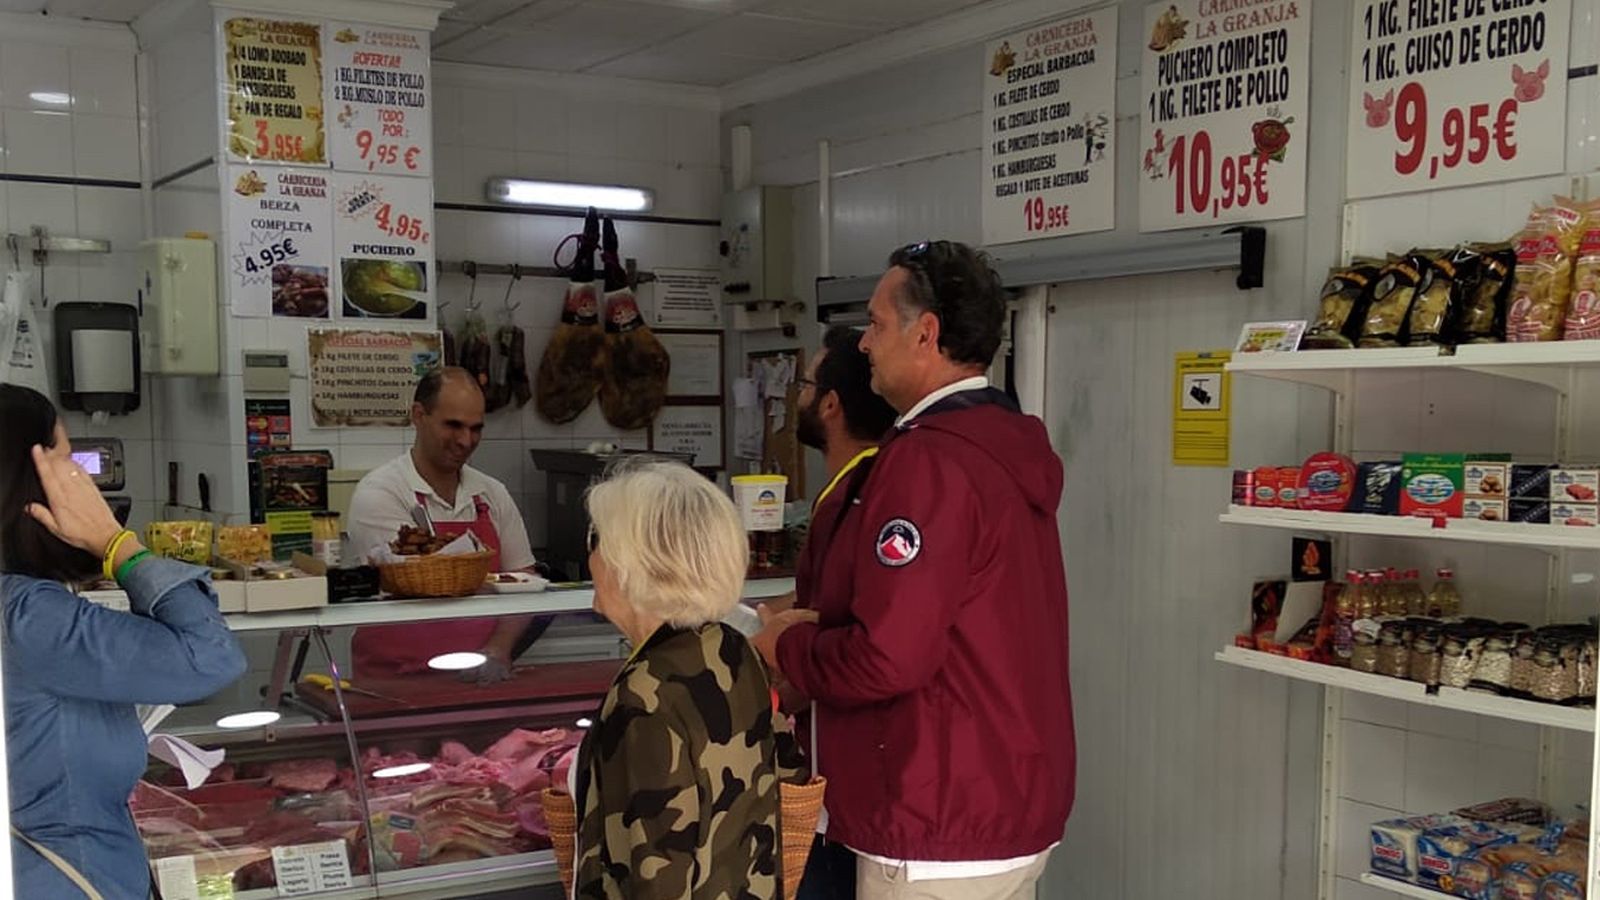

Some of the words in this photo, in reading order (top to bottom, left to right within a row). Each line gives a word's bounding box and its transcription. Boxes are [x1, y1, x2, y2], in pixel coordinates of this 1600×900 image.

[1025, 18, 1093, 48] CARNICERIA
[1196, 22, 1217, 39] LA
[1222, 2, 1299, 35] GRANJA
[1365, 5, 1372, 40] 1
[1378, 1, 1401, 37] KG.
[1408, 0, 1458, 31] FILETE
[248, 47, 269, 62] LOMO
[271, 50, 306, 66] ADOBADO
[1023, 48, 1040, 62] LA
[1044, 33, 1098, 57] GRANJA
[1158, 44, 1213, 86] PUCHERO
[1217, 28, 1288, 73] COMPLETO
[1363, 47, 1370, 83] 1
[1376, 42, 1399, 81] KG.
[1406, 30, 1454, 75] GUISO
[1459, 24, 1481, 64] DE
[1487, 11, 1545, 59] CERDO
[235, 65, 239, 79] 1
[241, 65, 276, 81] BANDEJA
[277, 69, 287, 83] DE
[335, 69, 339, 82] 1
[386, 73, 398, 88] DE
[399, 73, 424, 90] POLLO
[1007, 62, 1045, 84] ESPECIAL
[1047, 49, 1095, 74] BARBACOA
[335, 87, 340, 100] 2
[385, 91, 397, 105] DE
[398, 91, 425, 108] POLLO
[993, 95, 997, 108] 1
[1009, 87, 1029, 105] FILETE
[1029, 84, 1037, 100] DE
[1039, 79, 1060, 98] CERDO
[1149, 92, 1156, 123] 1
[1160, 88, 1178, 122] KG.
[1182, 79, 1221, 117] FILETE
[1225, 76, 1242, 110] DE
[1247, 66, 1289, 106] POLLO
[245, 105, 261, 117] PAN
[263, 106, 273, 118] DE
[274, 105, 302, 119] REGALO
[377, 109, 404, 123] TODO
[993, 118, 996, 132] 1
[1008, 109, 1038, 128] COSTILLAS
[1040, 107, 1047, 122] DE
[1050, 102, 1070, 120] CERDO
[255, 120, 305, 160] 3,95€
[993, 143, 996, 156] 1
[1008, 132, 1039, 152] PINCHITOS
[1061, 132, 1065, 141] o
[1067, 124, 1084, 139] Pollo
[1395, 82, 1518, 179] 9,95€
[278, 173, 326, 187] CARNICERIA
[992, 165, 996, 179] 1
[1008, 154, 1056, 176] HAMBURGUESAS
[1168, 130, 1270, 218] 10,95€
[279, 185, 291, 196] LA
[293, 185, 326, 198] GRANJA
[996, 181, 1018, 197] REGALO
[1020, 180, 1023, 193] 1
[1025, 177, 1040, 193] BOTE
[1042, 175, 1050, 190] DE
[1053, 170, 1089, 188] ACEITUNAS
[260, 199, 300, 213] BERZA
[1023, 197, 1069, 232] 19,95€
[251, 218, 312, 233] COMPLETA
[353, 244, 415, 256] PUCHERO
